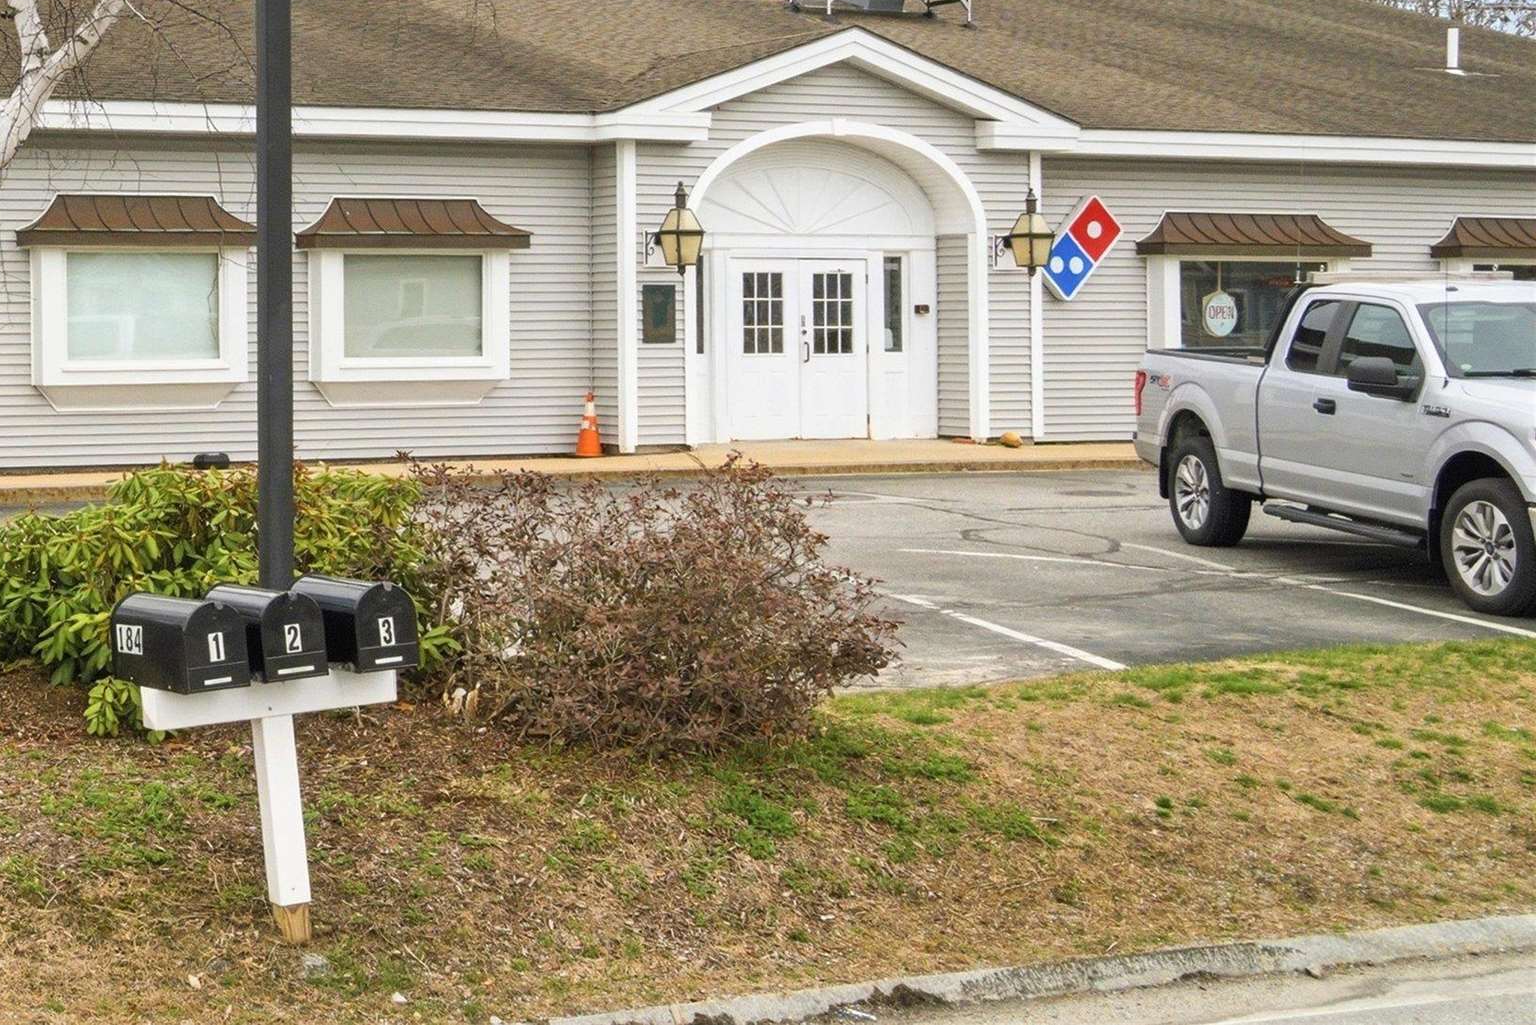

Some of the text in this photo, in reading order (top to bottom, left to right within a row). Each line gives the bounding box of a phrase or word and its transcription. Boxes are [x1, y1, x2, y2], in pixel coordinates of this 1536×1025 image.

[118, 627, 142, 653] 184
[287, 626, 300, 651] 2
[382, 619, 394, 644] 3
[212, 634, 222, 660] 1
